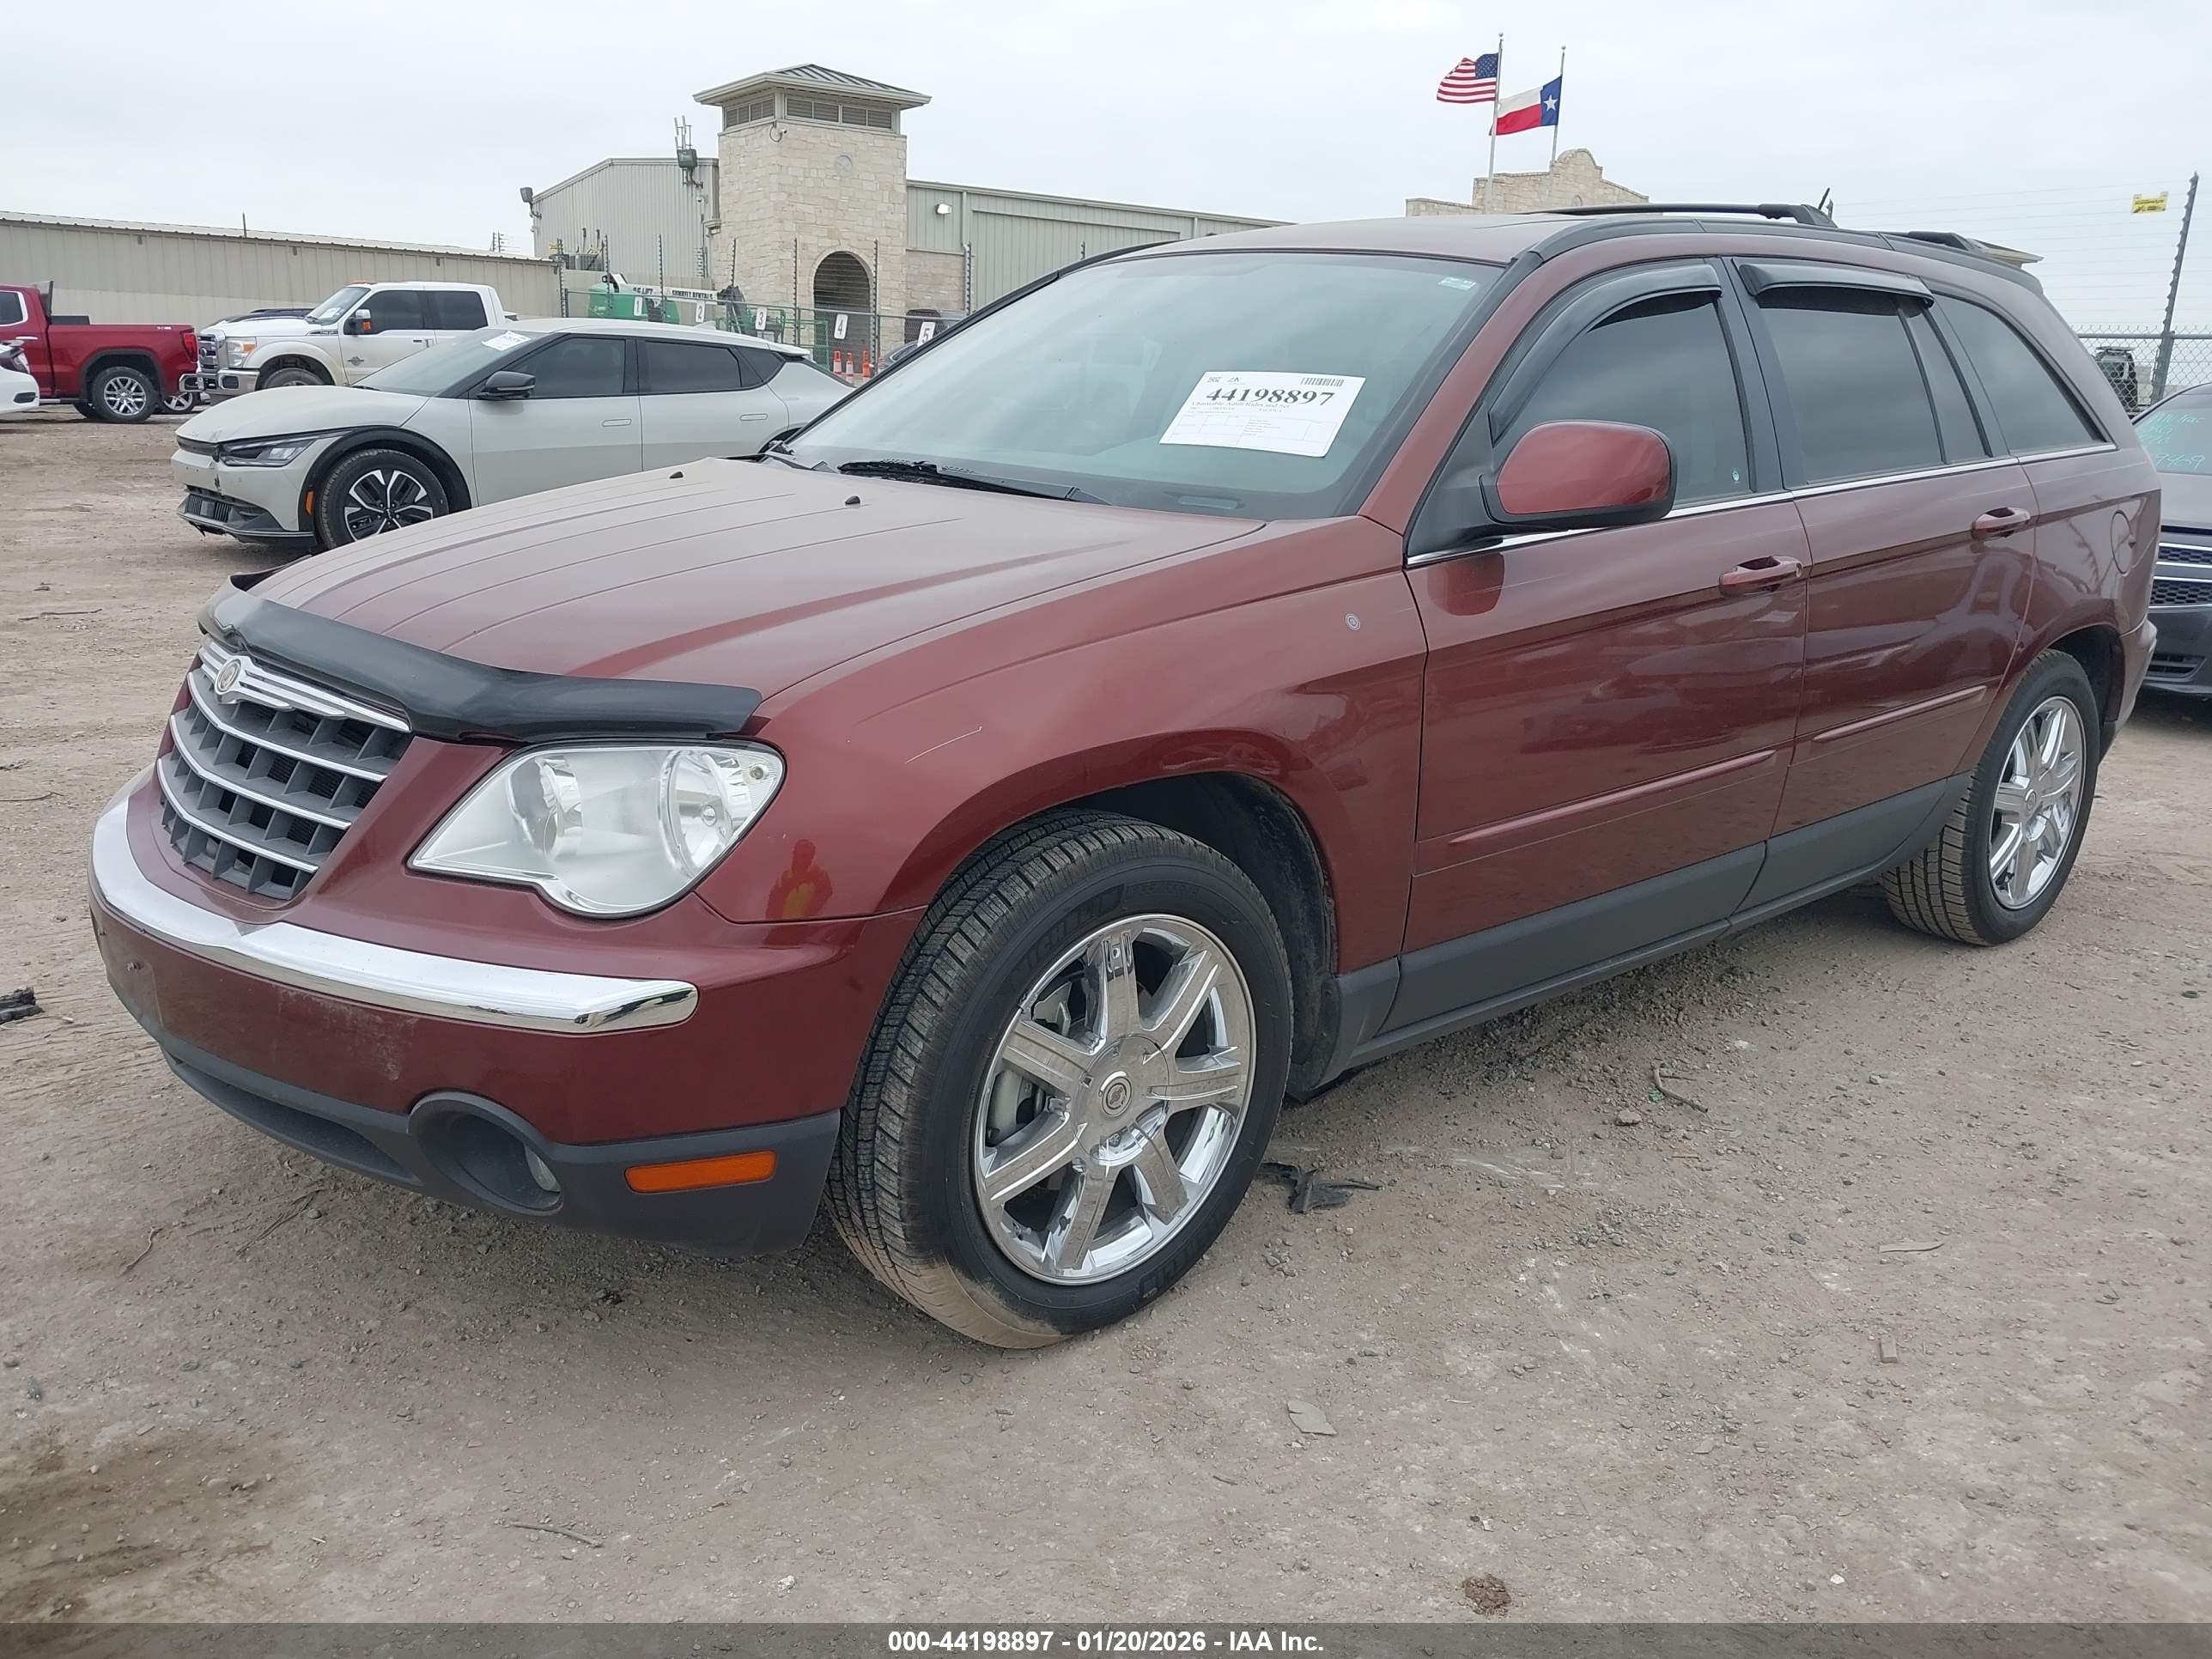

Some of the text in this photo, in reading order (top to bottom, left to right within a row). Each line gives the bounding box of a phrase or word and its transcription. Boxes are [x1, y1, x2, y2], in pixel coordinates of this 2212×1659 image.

[635, 300, 641, 315] 1
[697, 306, 704, 319] 2
[757, 312, 764, 325] 3
[837, 319, 845, 336] 4
[922, 327, 930, 343] 5
[1206, 388, 1335, 405] 44198897
